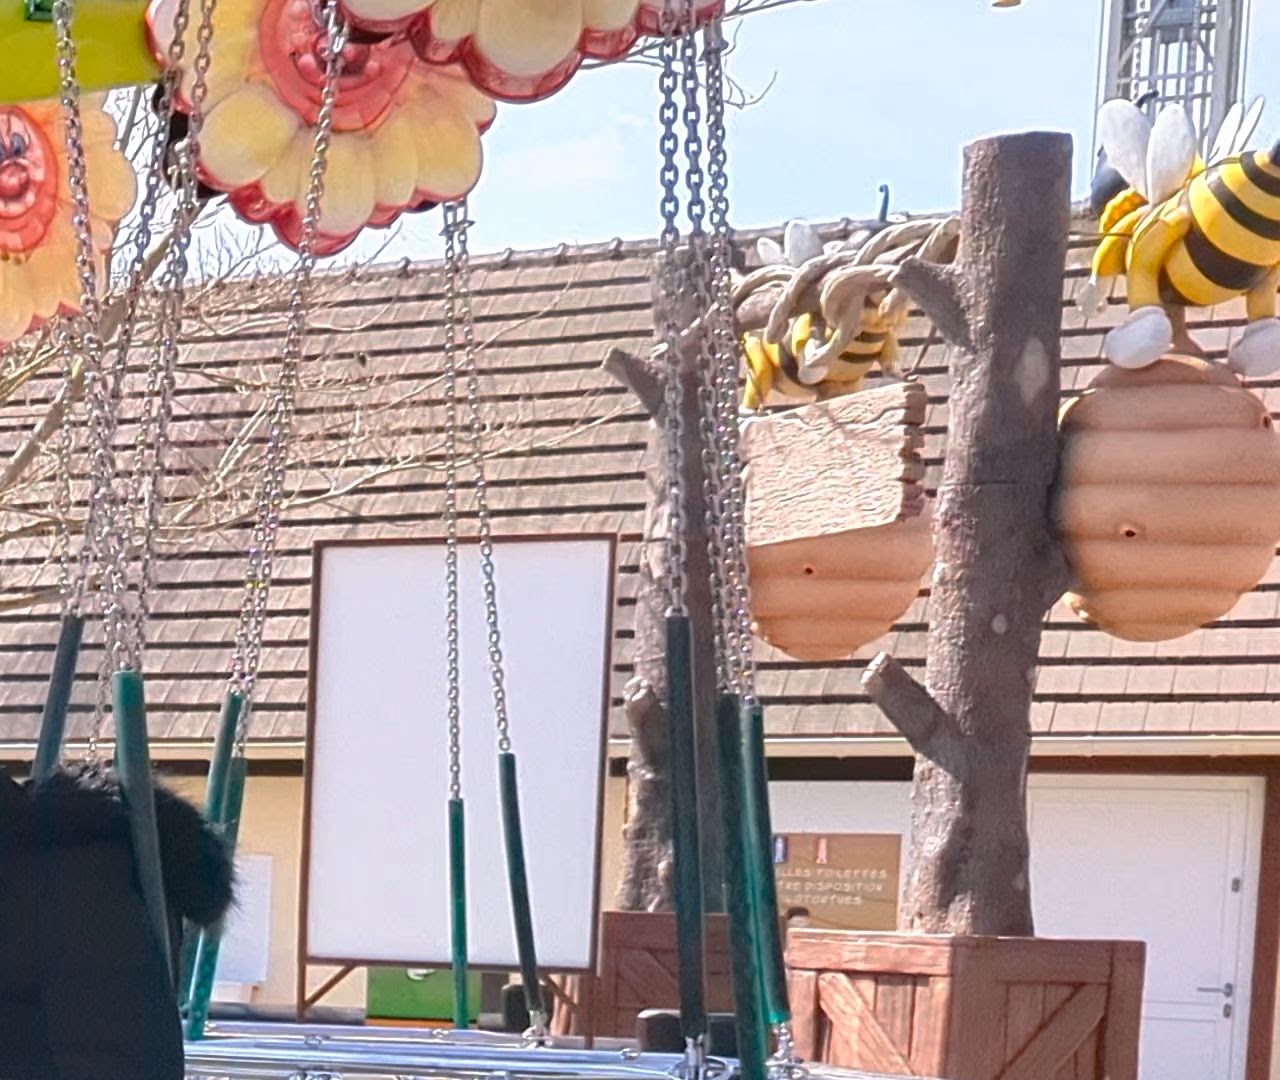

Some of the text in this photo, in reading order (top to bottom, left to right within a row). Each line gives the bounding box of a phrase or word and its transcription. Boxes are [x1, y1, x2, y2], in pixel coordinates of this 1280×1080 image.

[816, 868, 887, 879] TOILETTES
[777, 880, 882, 892] TRE DISPOSITION
